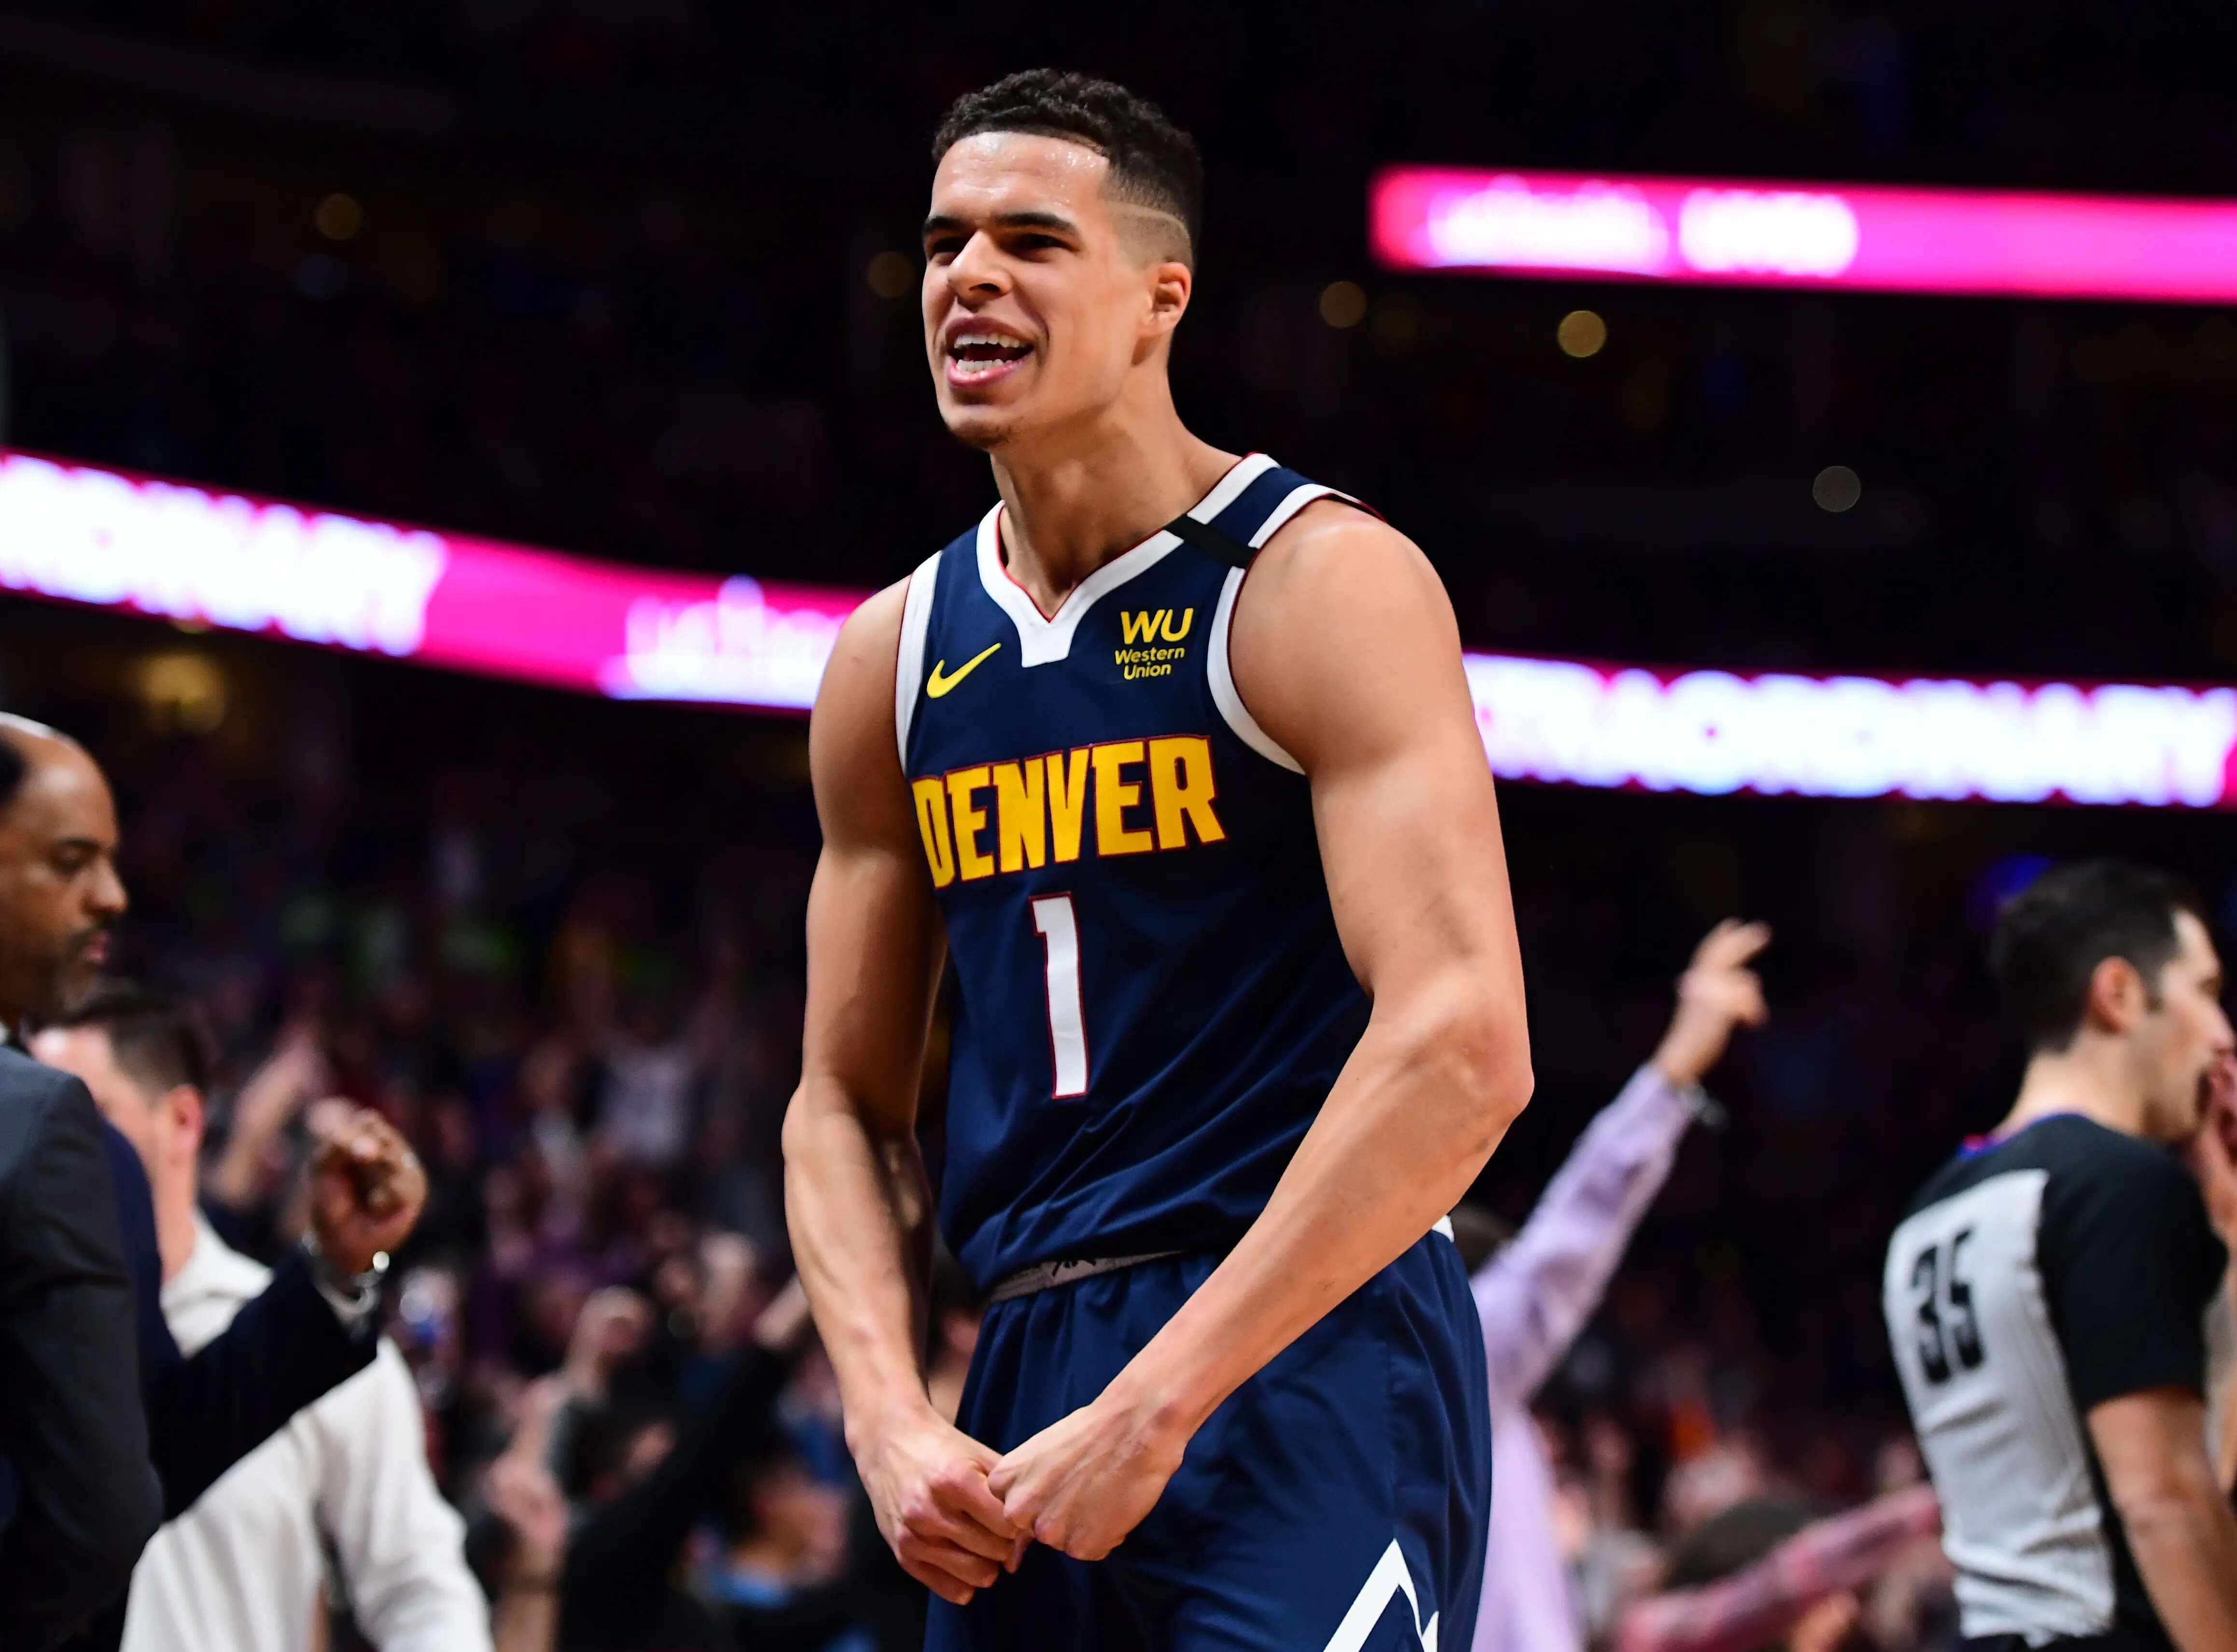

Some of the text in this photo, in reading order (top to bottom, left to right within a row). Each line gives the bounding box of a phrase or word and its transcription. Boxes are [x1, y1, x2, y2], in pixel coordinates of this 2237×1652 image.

[1115, 647, 1185, 665] Western
[1120, 607, 1194, 645] WU
[1123, 662, 1172, 680] Union
[909, 734, 1229, 889] DENVER
[1028, 891, 1090, 1100] 1
[1910, 1226, 1986, 1385] 35
